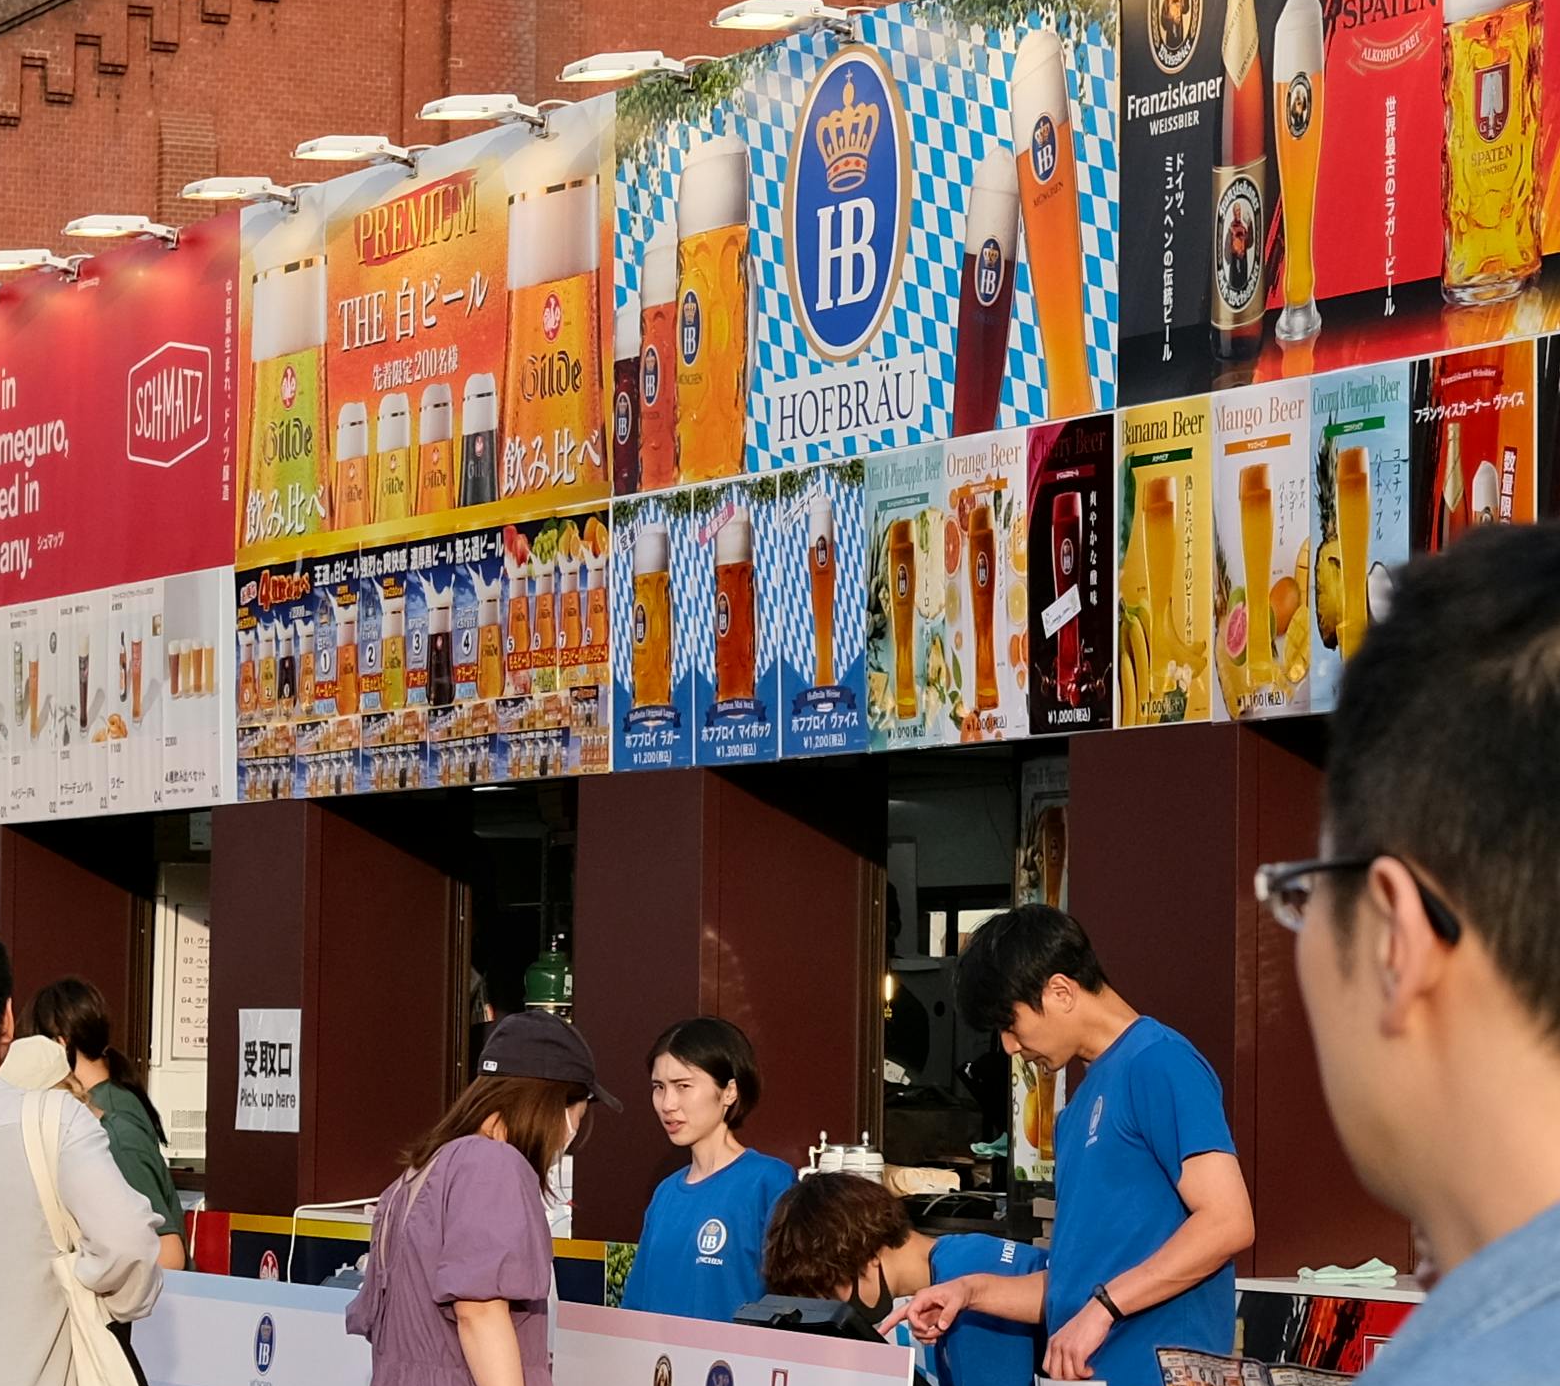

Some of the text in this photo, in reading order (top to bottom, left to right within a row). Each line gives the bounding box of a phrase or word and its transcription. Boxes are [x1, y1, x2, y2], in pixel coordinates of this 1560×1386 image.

[1361, 31, 1421, 64] ALKOHOLFREI
[1127, 74, 1223, 121] Franziskaner
[1149, 109, 1200, 137] WEISSBIER
[1470, 145, 1514, 168] SPATEN
[357, 180, 479, 263] PREMIUM
[1383, 95, 1397, 318] 世界最古のラガービール
[815, 195, 877, 313] HB
[337, 270, 490, 353] THE 白ビール
[371, 344, 459, 392] 先着限定200名様
[1, 371, 17, 409] in
[135, 367, 203, 444] SCHMATZ
[777, 362, 917, 443] HOFBRÄU
[1414, 389, 1525, 425] フランツィスカーナー ヴァイス
[1121, 410, 1205, 446] Banana Beer
[1215, 396, 1305, 437] Mango Beer
[503, 427, 602, 494] 飲み比べ
[947, 442, 1022, 479] Orange Beer
[1031, 428, 1107, 463] Cherry Beer
[23, 475, 40, 515] in
[246, 482, 328, 543] 飲み比べ
[36, 529, 65, 551] シュマッツ
[243, 1040, 293, 1079] 受取口
[240, 1087, 296, 1111] Pick up here
[702, 1234, 717, 1250] HB
